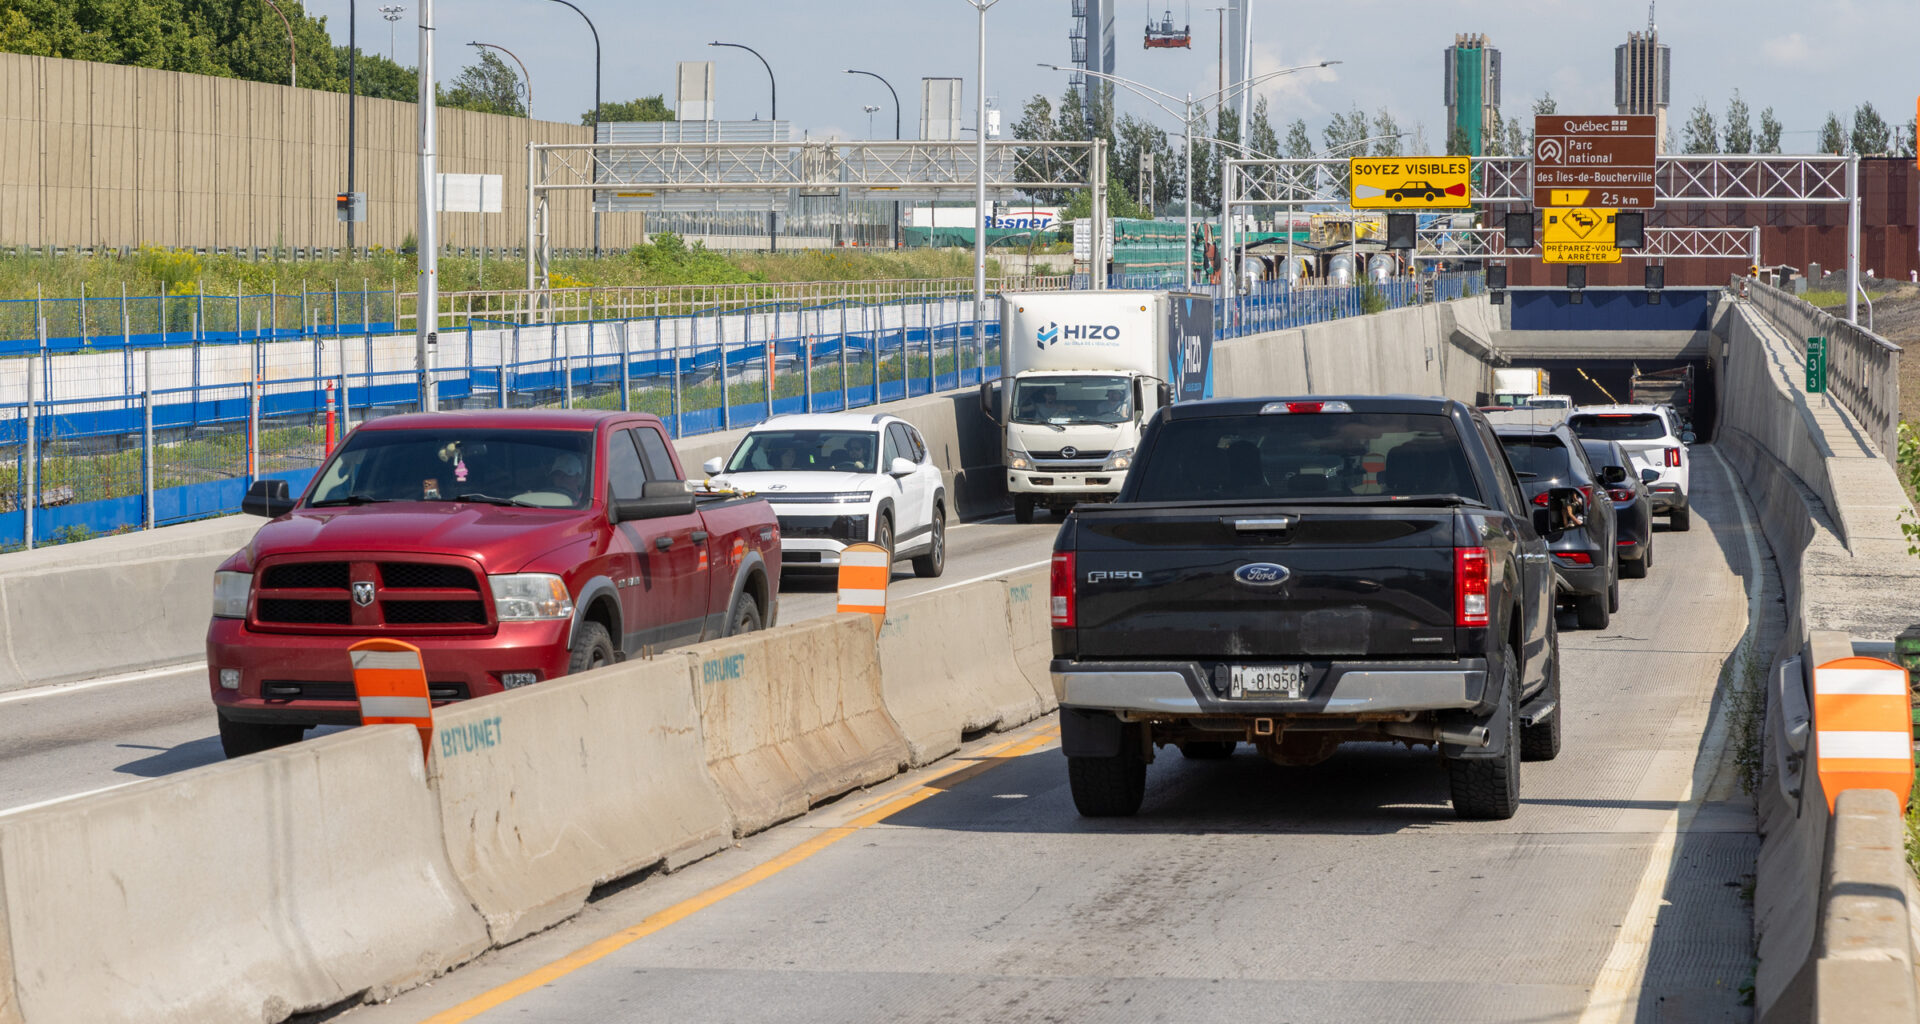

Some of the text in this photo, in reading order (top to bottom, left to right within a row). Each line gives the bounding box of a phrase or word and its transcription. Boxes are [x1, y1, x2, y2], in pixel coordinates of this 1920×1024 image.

[1564, 120, 1609, 133] Québec
[1569, 139, 1592, 150] Parc
[1569, 153, 1612, 163] national
[1355, 163, 1466, 175] SOYEZ VISIBLES
[1537, 172, 1553, 182] des
[1565, 191, 1639, 205] 1 2,5 km
[1064, 325, 1120, 340] HIZO
[1185, 335, 1202, 374] HIZO
[1247, 567, 1277, 580] Ford
[703, 653, 745, 684] BRUNET
[1233, 673, 1248, 691] AL
